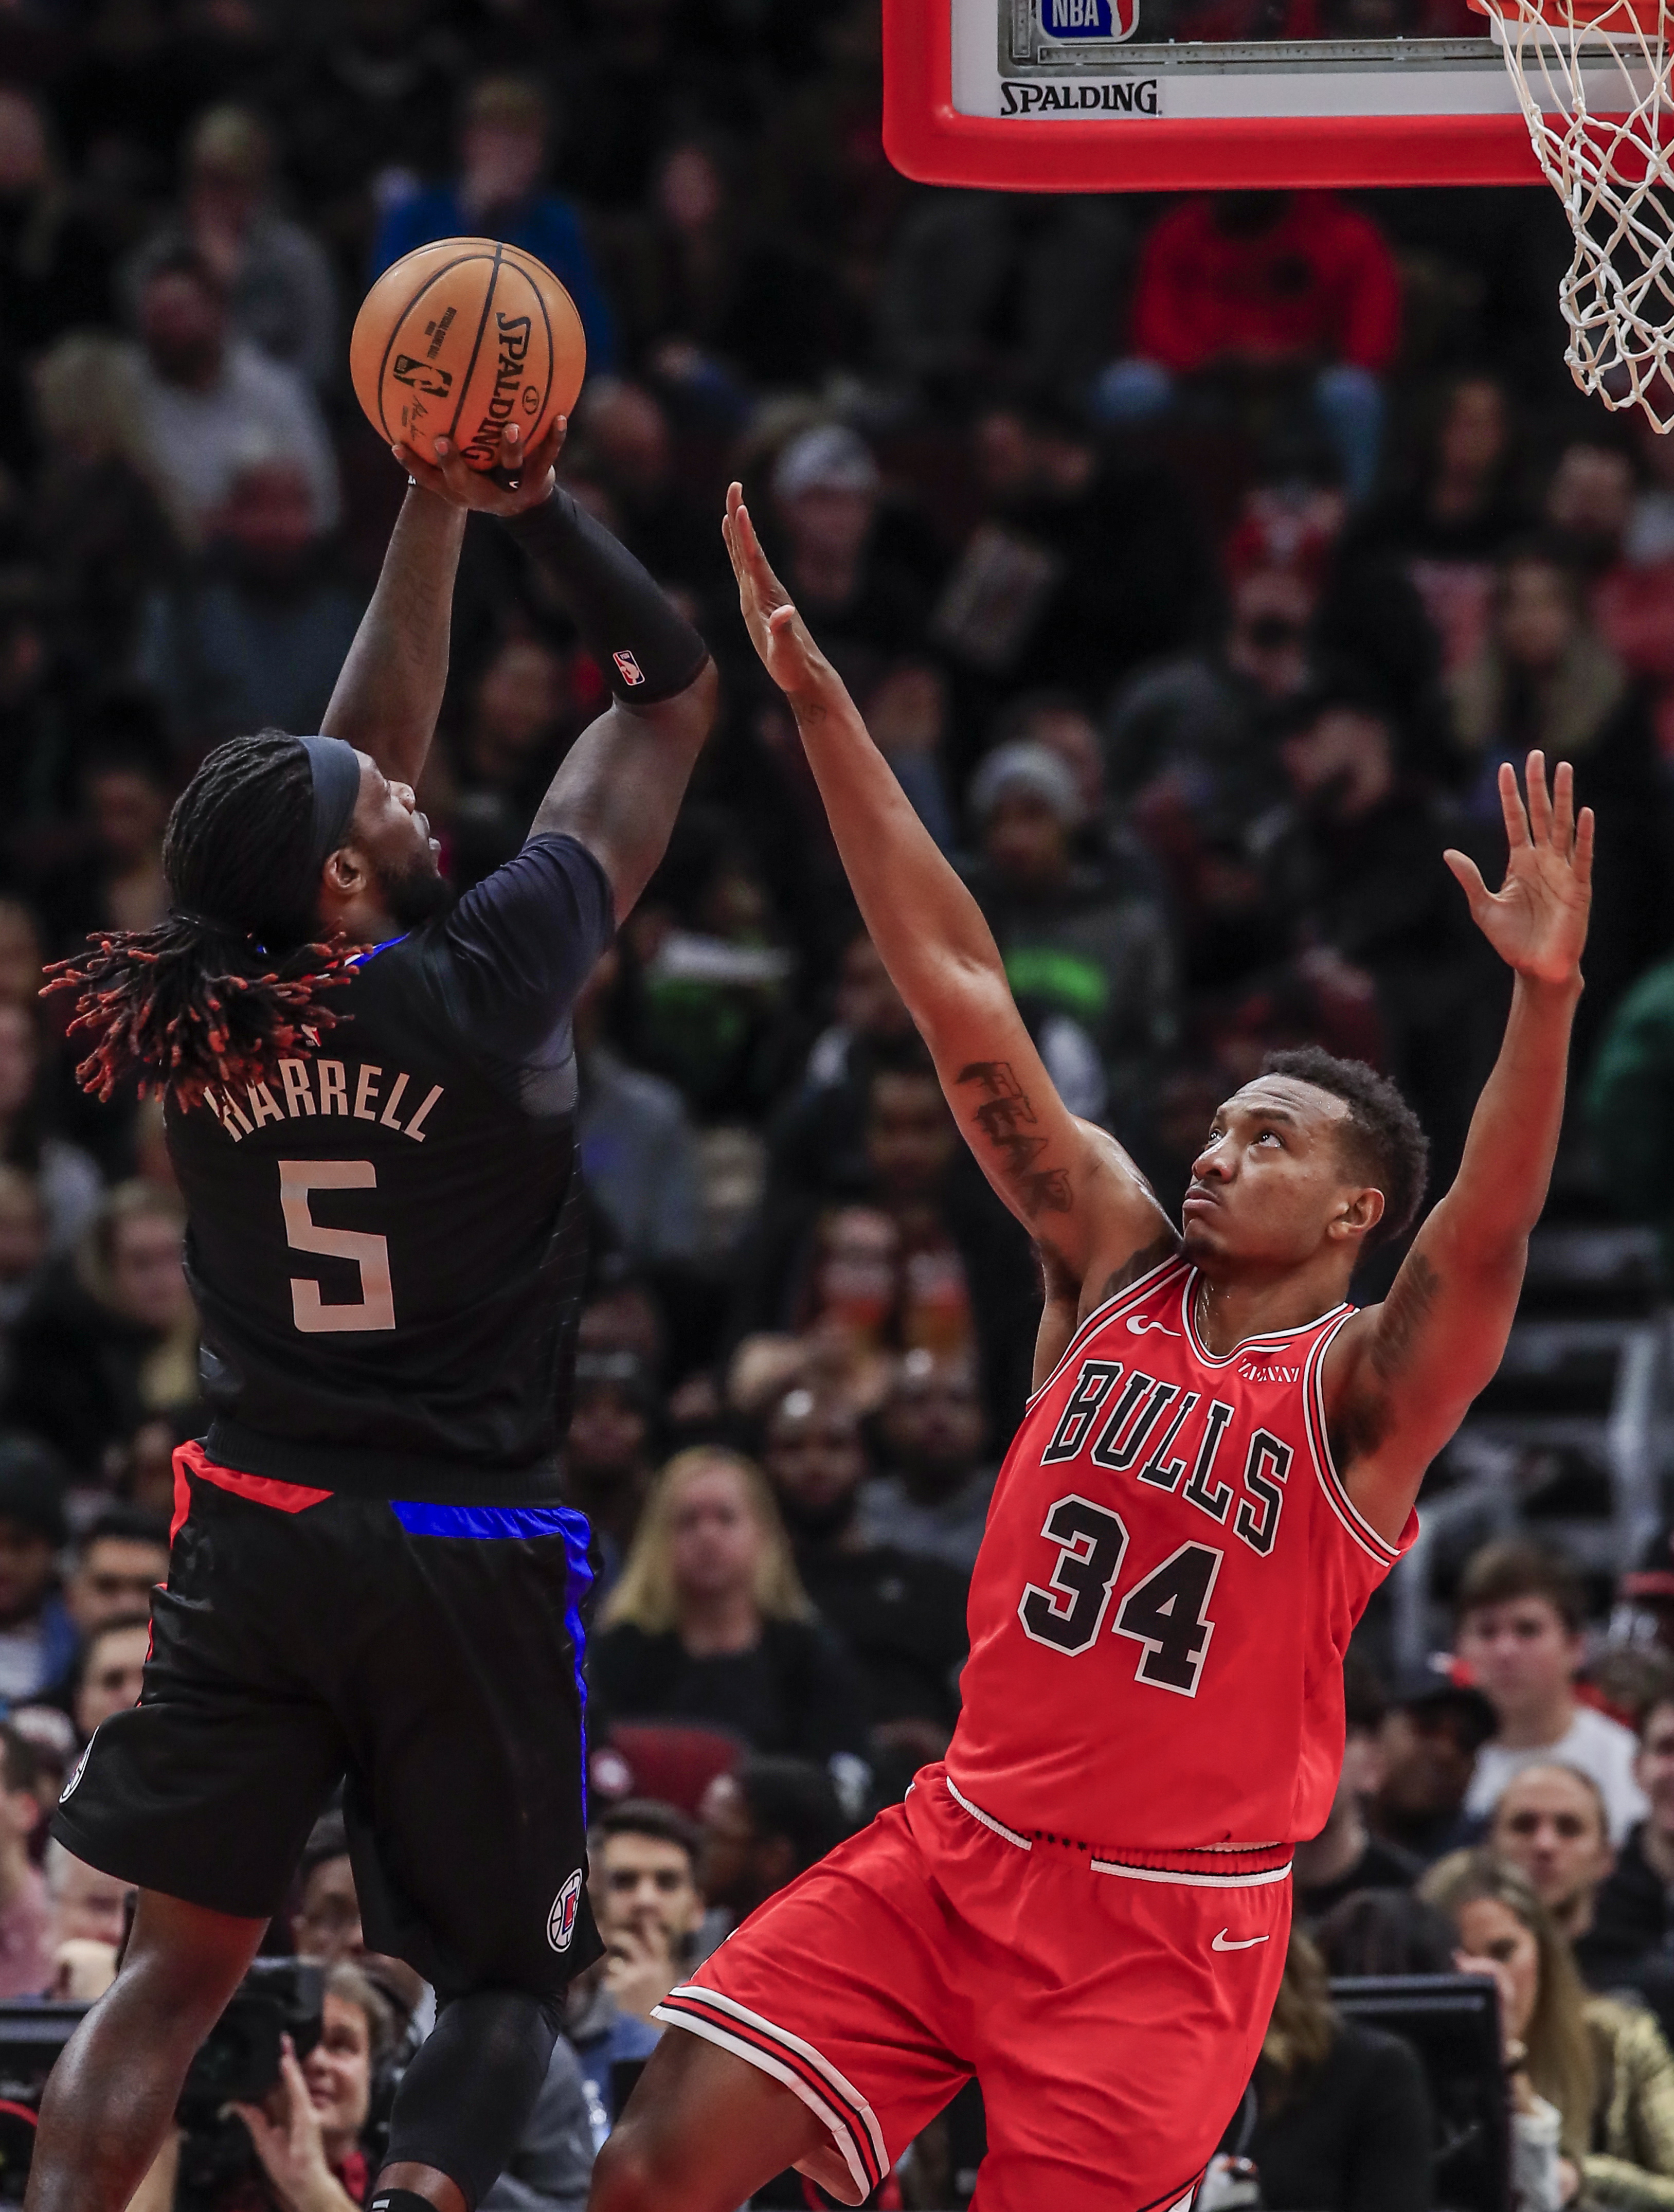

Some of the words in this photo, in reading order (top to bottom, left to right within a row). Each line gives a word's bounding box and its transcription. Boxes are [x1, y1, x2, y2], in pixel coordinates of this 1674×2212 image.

[1052, 0, 1099, 27] NBA
[1001, 79, 1157, 115] SPALDING
[463, 312, 531, 461] SPALDING
[203, 1059, 444, 1142] HARRELL
[278, 1160, 396, 1333] 5
[1040, 1359, 1294, 1557] BULLS
[1018, 1494, 1224, 1698] 34
